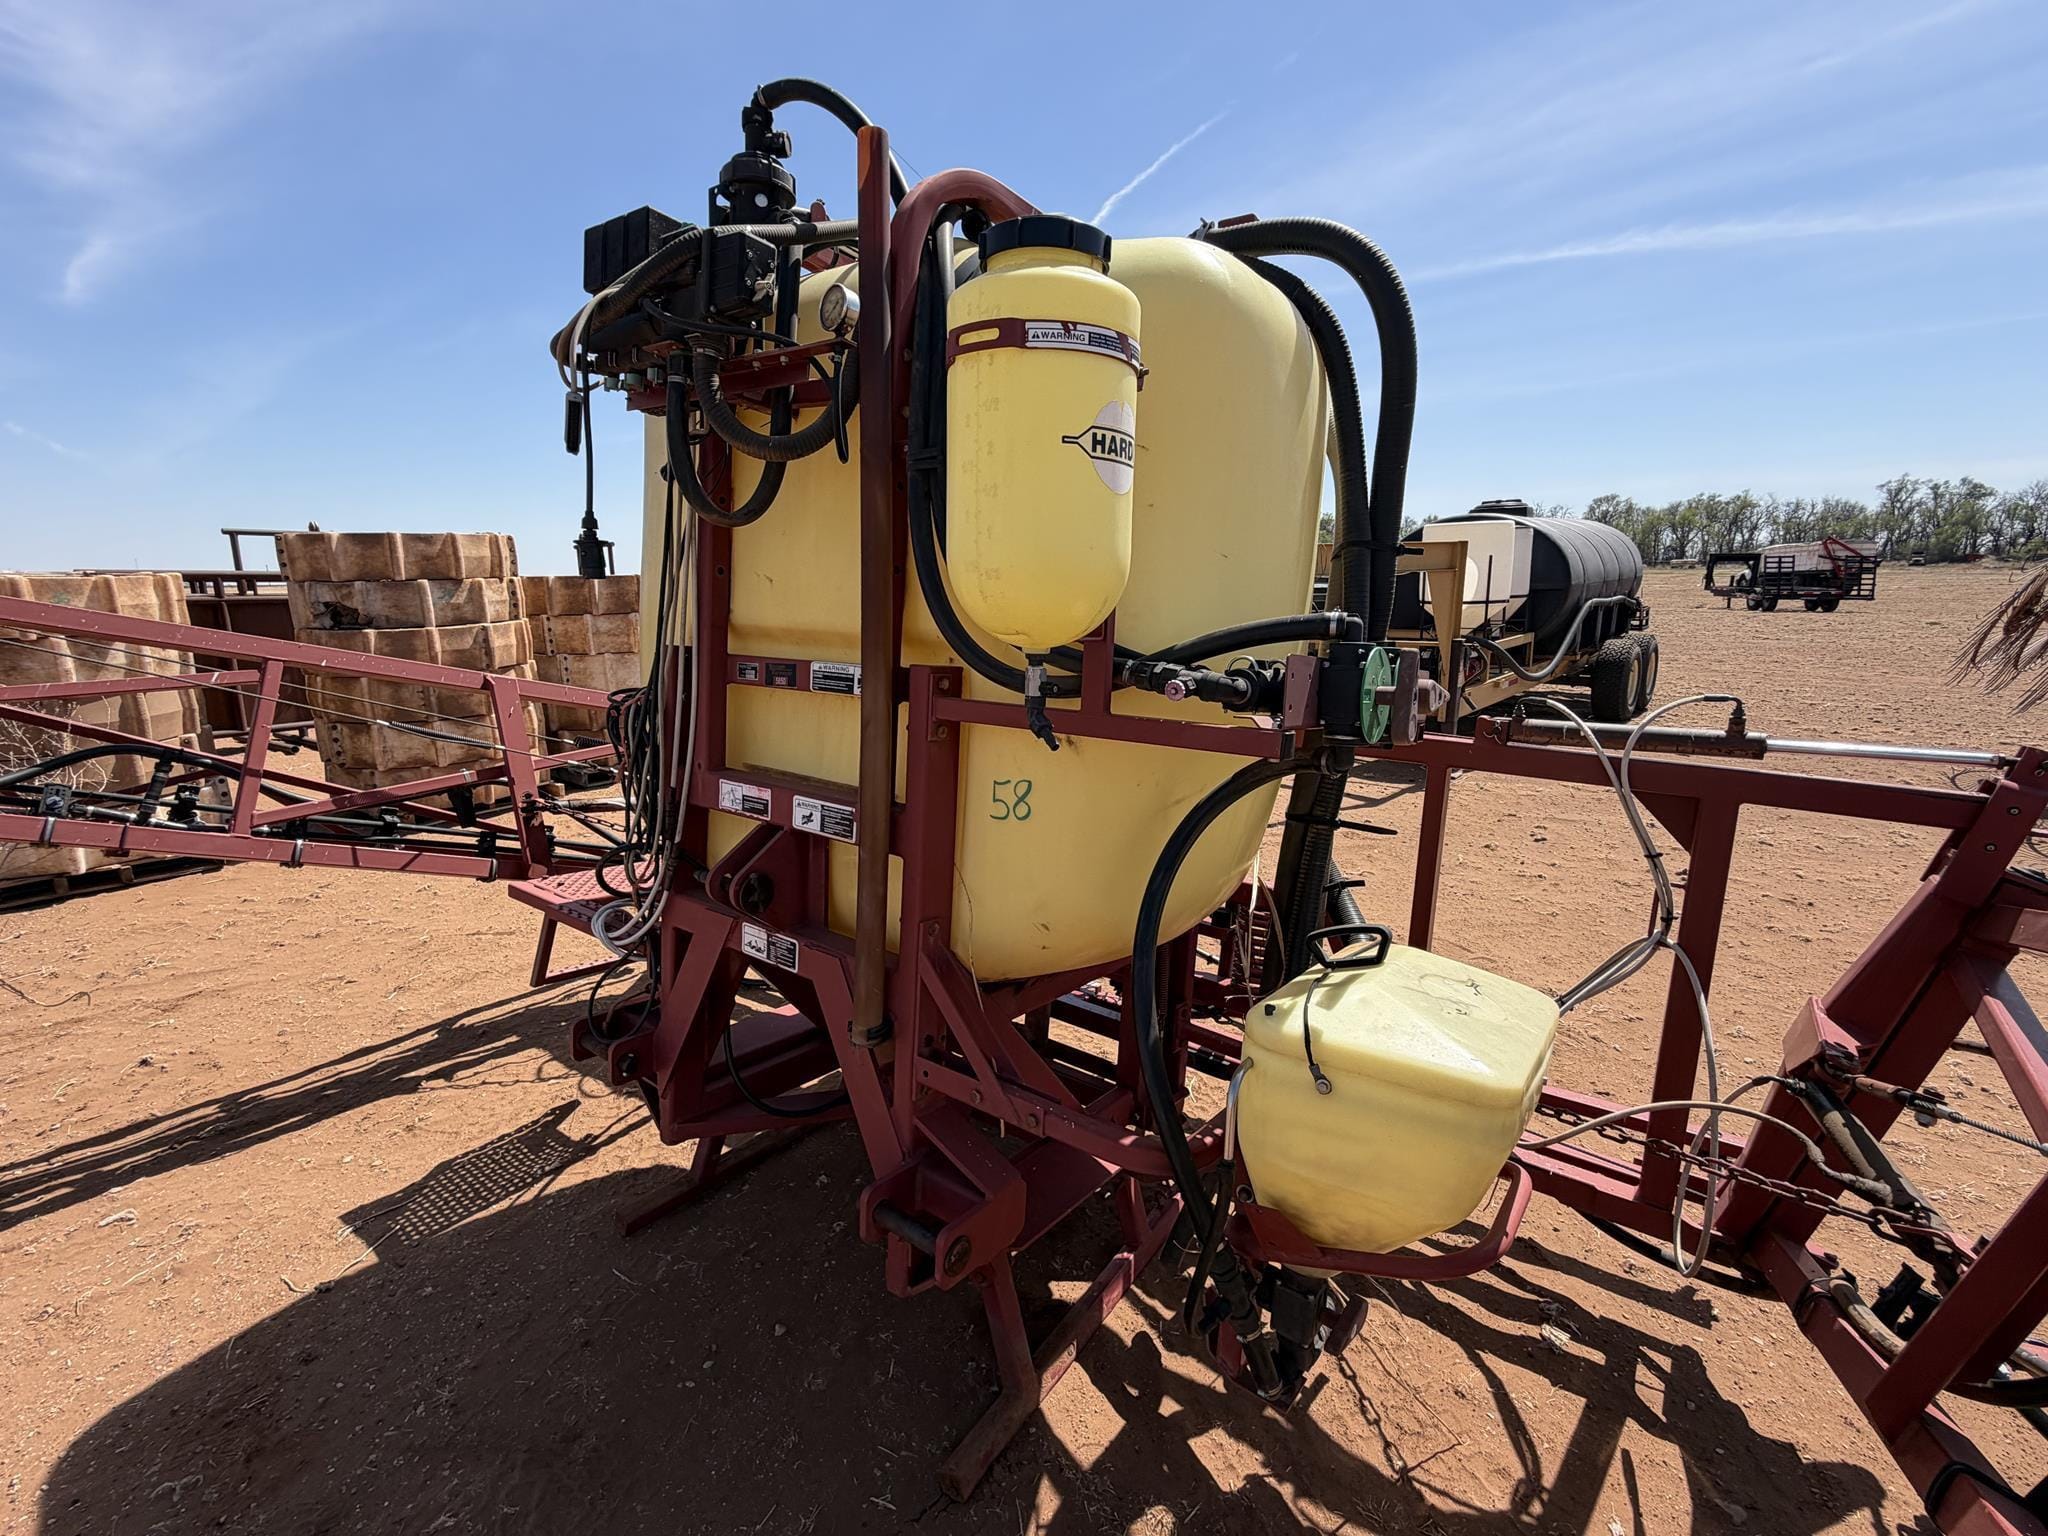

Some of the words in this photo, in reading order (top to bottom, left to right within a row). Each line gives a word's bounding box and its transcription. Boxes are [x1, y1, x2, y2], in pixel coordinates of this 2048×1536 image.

[1041, 331, 1085, 342] WARNING
[823, 664, 850, 673] WARNING
[989, 779, 1032, 821] 58
